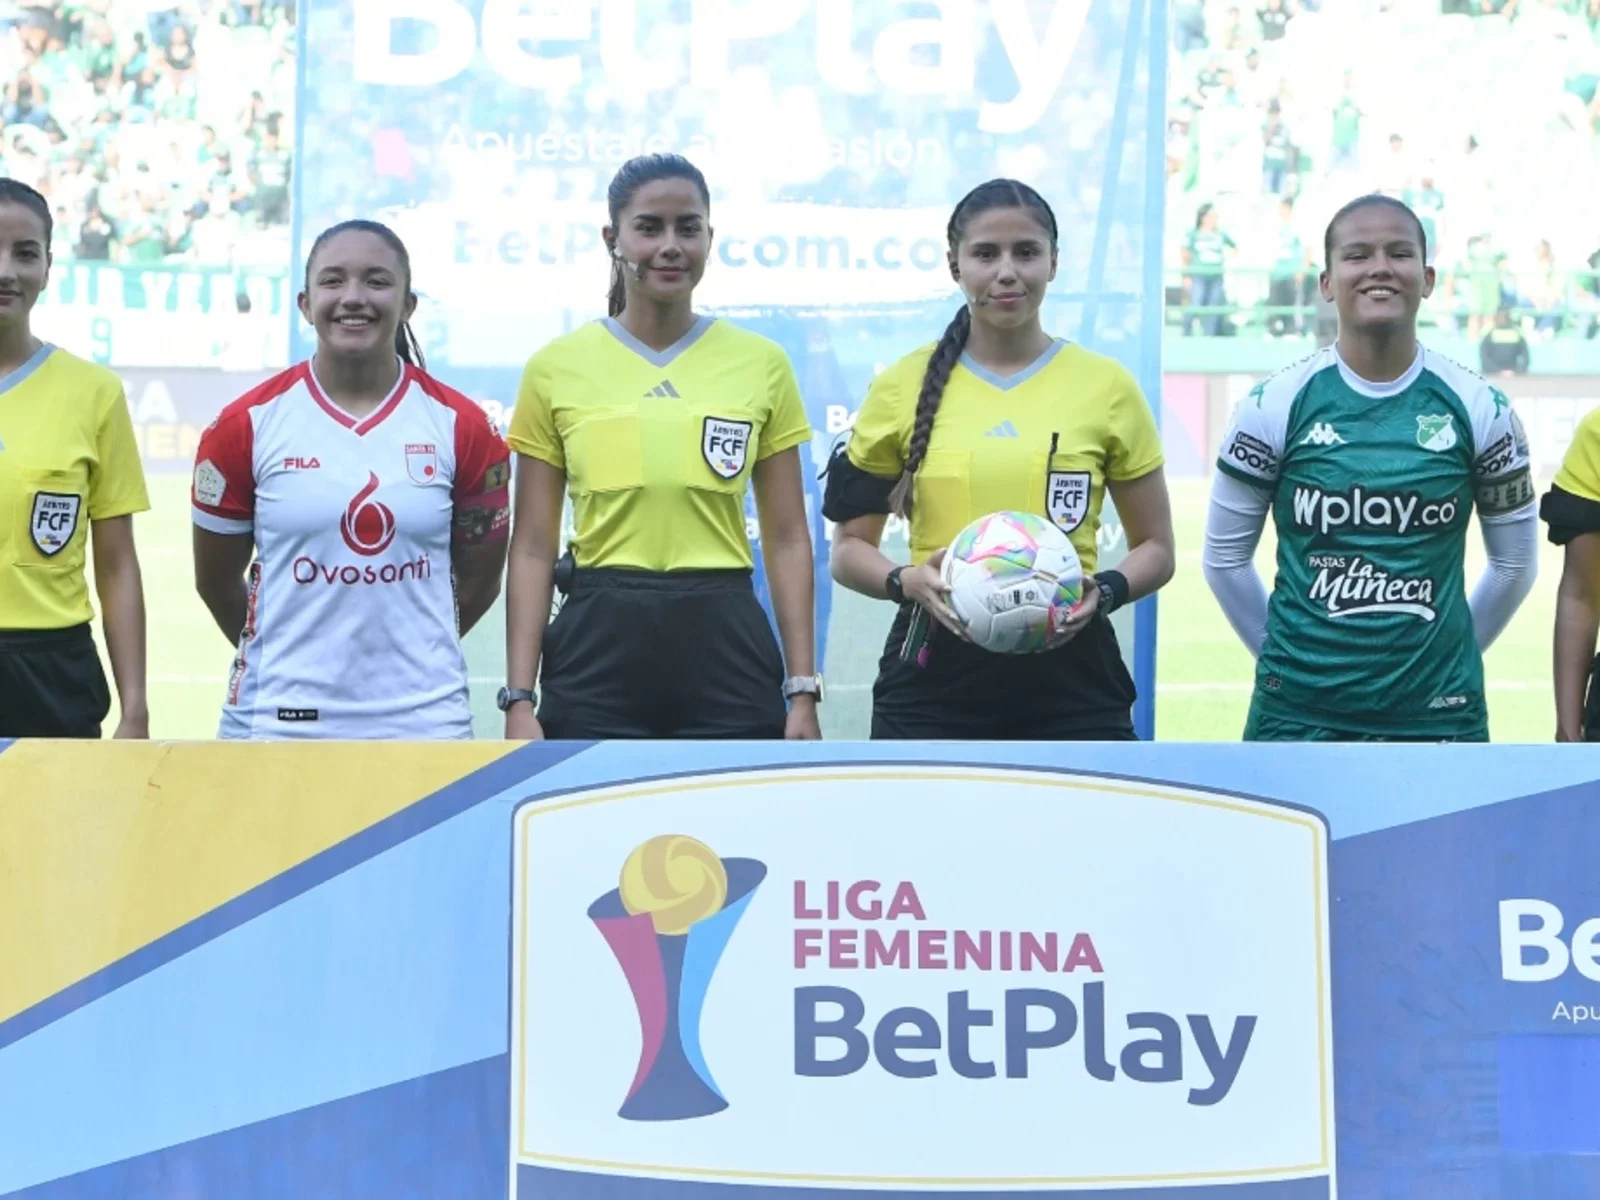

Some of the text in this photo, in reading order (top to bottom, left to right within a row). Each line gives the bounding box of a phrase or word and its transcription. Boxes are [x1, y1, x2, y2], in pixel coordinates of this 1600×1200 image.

[453, 219, 944, 272] BetP.com.co
[709, 435, 744, 457] FCF
[1228, 442, 1277, 474] 100%
[284, 457, 320, 470] FILA
[1474, 449, 1514, 476] 00%
[1052, 489, 1083, 509] FCF
[1293, 487, 1456, 534] Wplay.co
[37, 510, 71, 531] FCF
[293, 553, 431, 585] Ovosanti
[1309, 556, 1374, 578] PASTAS La
[1309, 568, 1433, 611] Muñeca
[792, 879, 927, 921] LIGA
[792, 928, 1104, 973] FEMENINA
[1551, 1000, 1600, 1024] Apu
[792, 980, 1259, 1106] BetPlay
